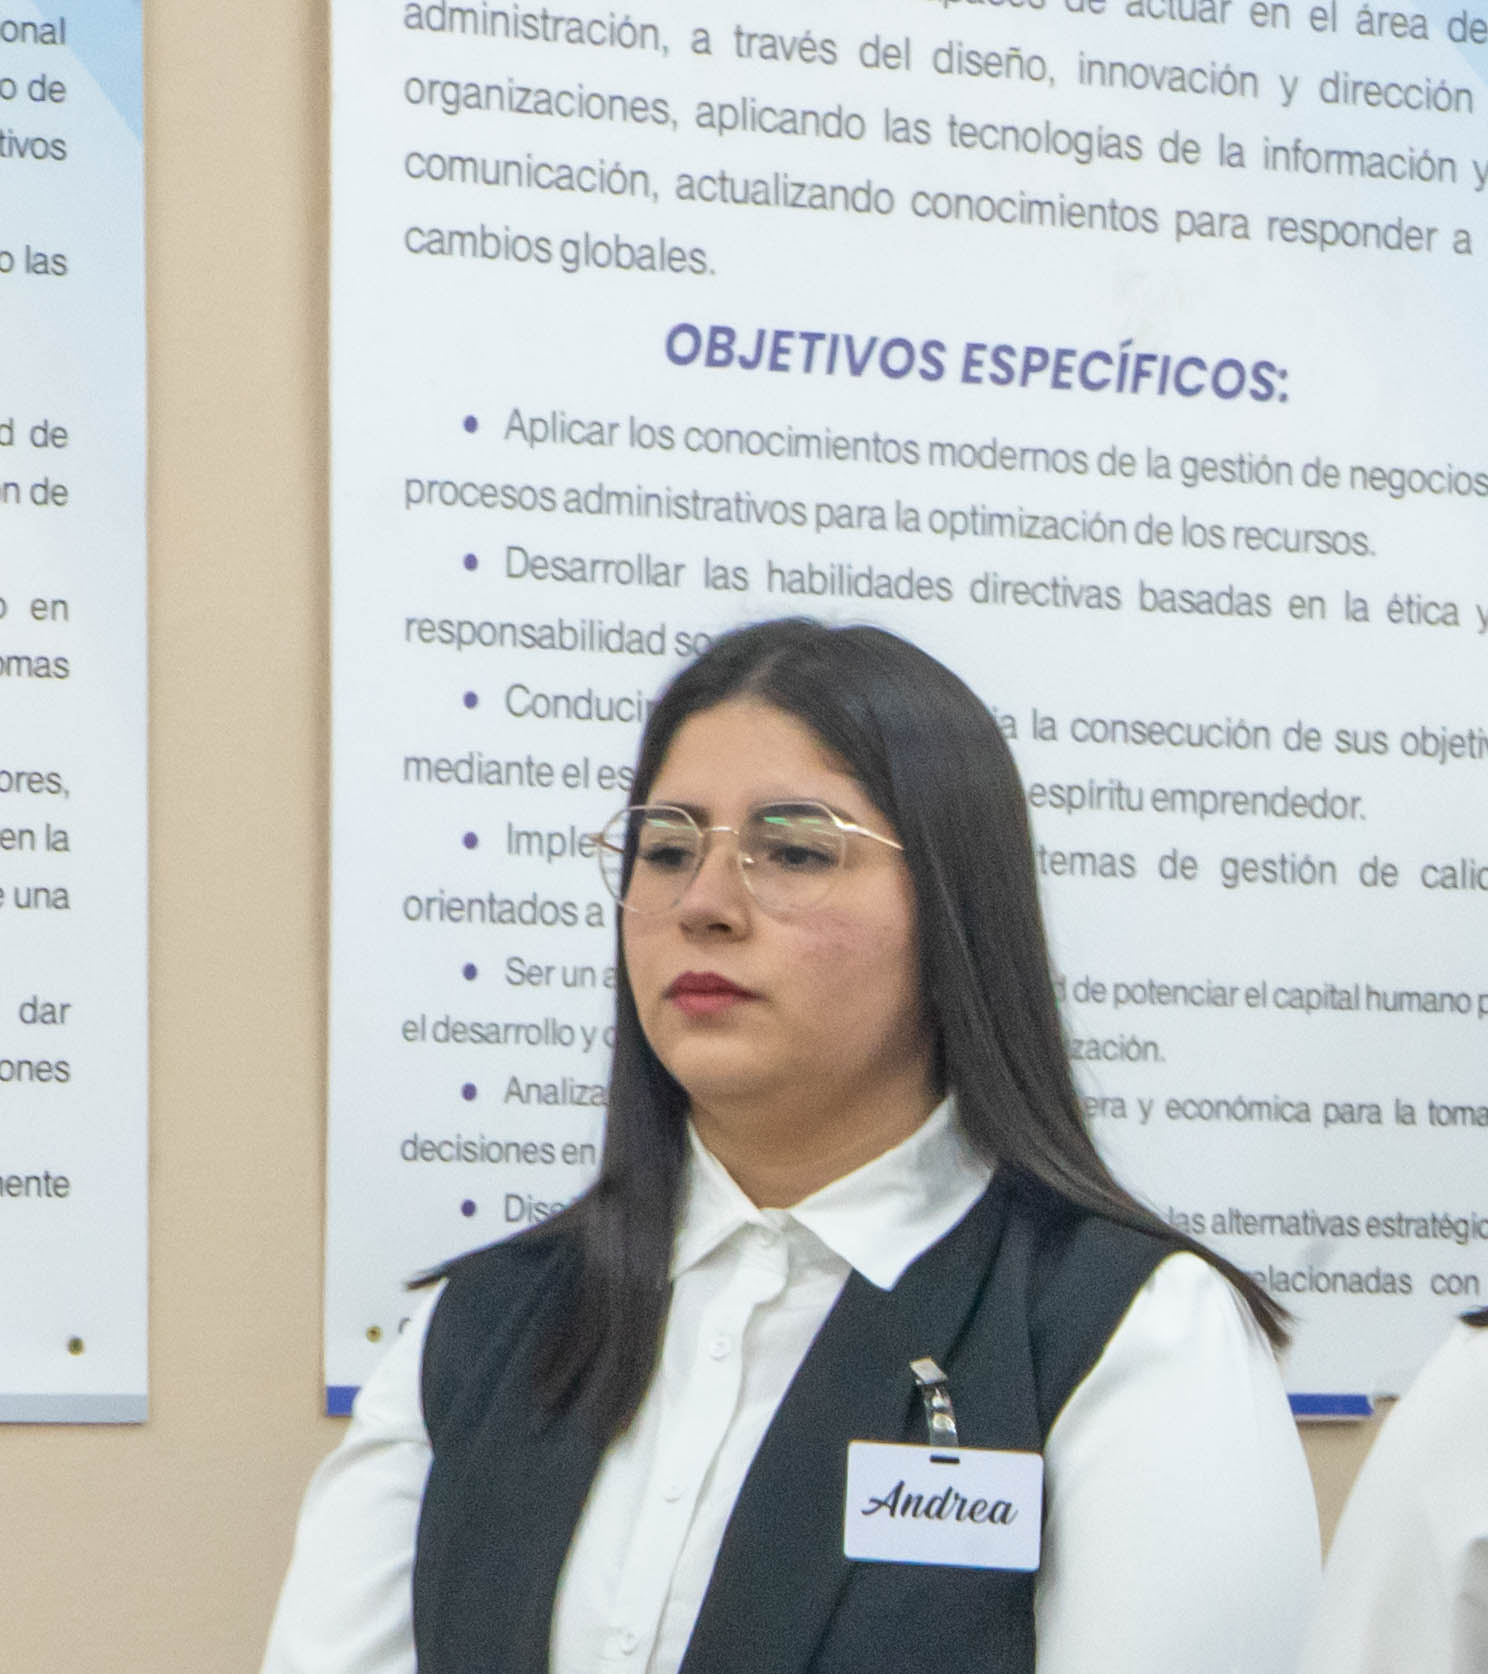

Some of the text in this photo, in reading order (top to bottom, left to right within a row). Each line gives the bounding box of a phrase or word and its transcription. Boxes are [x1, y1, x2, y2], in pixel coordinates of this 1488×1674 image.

[403, 0, 670, 58] administración,
[690, 26, 713, 56] a
[732, 23, 839, 66] través
[858, 33, 911, 71] del
[931, 39, 1056, 88] diseño,
[1078, 50, 1259, 99] innovación
[1278, 74, 1299, 108] y
[1318, 69, 1474, 115] dirección
[404, 151, 659, 204] comunicación,
[674, 169, 896, 216] actualizando
[910, 189, 1160, 235] conocimientos
[1174, 209, 1252, 244] para
[1267, 215, 1439, 253] responder
[1451, 228, 1473, 256] a
[24, 244, 70, 277] las
[403, 223, 716, 276] cambios globales.
[664, 322, 1289, 404] OBJETIVOS ESPECÍFICOS:
[505, 544, 687, 588] Desarrollar
[703, 556, 750, 593] las
[766, 559, 955, 603] habilidades
[969, 571, 1123, 612] directivas
[1138, 578, 1273, 619] basadas
[1287, 593, 1327, 621] en
[1344, 589, 1371, 623] la
[1385, 592, 1461, 628] ética
[1031, 707, 1059, 743] la
[1069, 716, 1272, 751] consecución
[1282, 719, 1323, 753] de
[1334, 728, 1390, 757] sus
[1149, 785, 1367, 822] emprendedor.
[1157, 847, 1199, 882] de
[1220, 851, 1337, 890] gestión
[1358, 854, 1400, 889] de
[17, 994, 73, 1026] dar
[1210, 1207, 1362, 1239] alternativas
[861, 1479, 1019, 1526] Andrea
